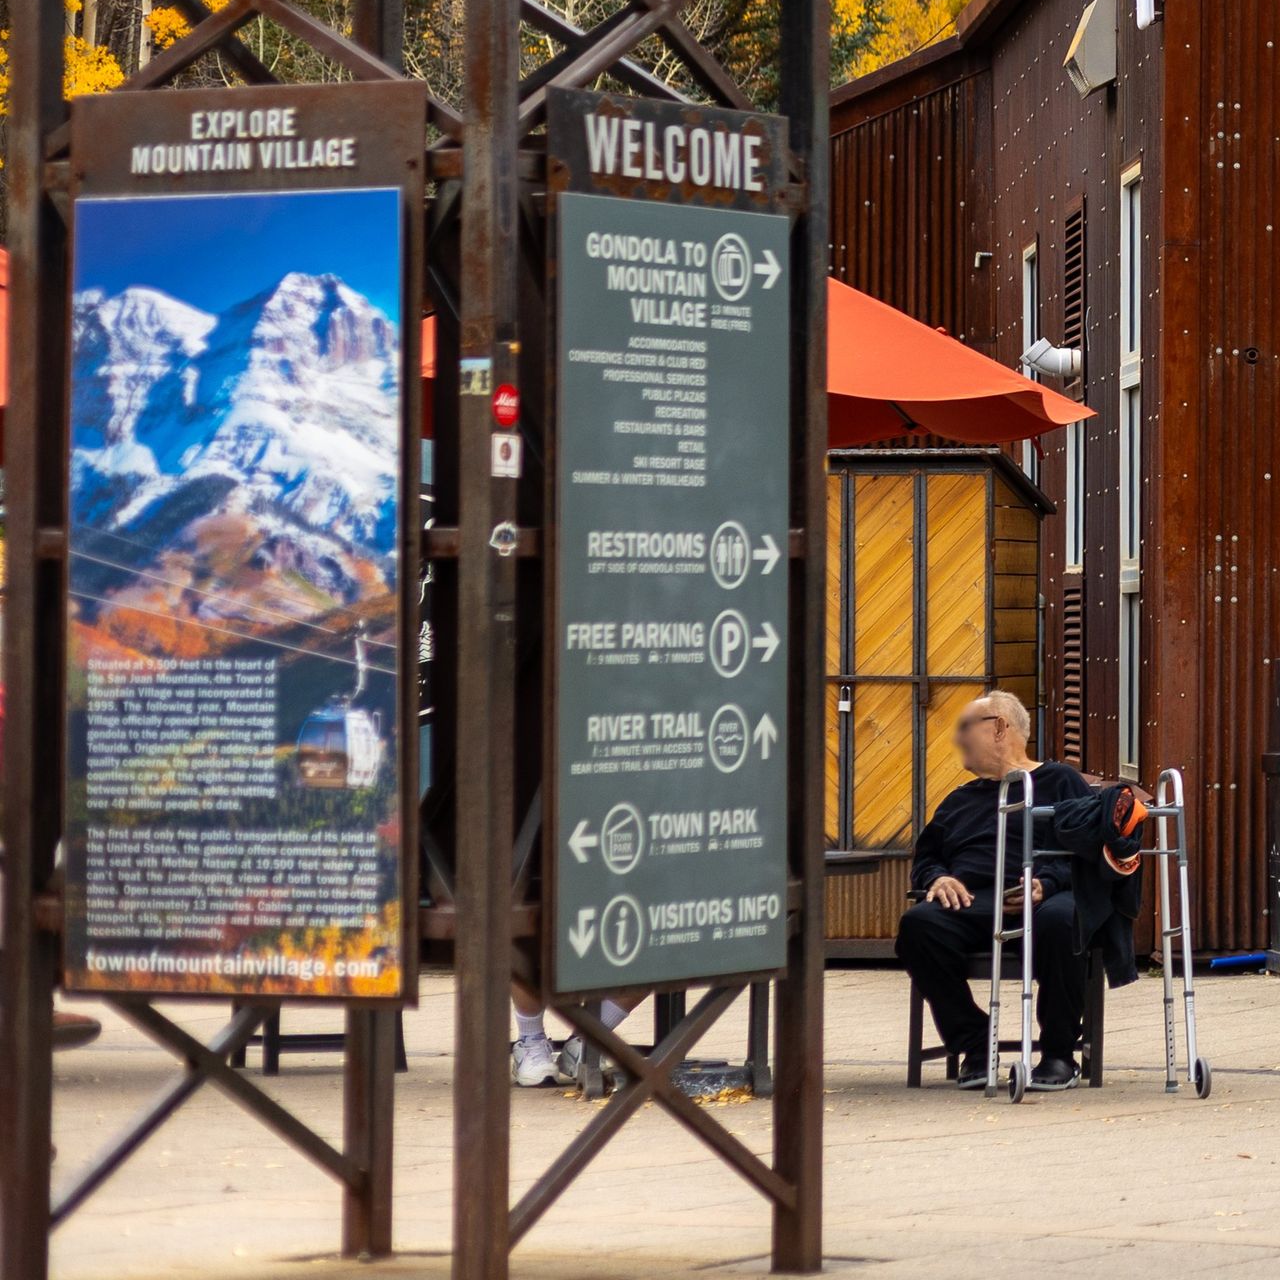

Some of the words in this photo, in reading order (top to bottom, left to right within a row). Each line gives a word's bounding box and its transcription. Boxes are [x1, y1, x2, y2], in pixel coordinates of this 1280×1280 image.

[190, 109, 296, 141] EXPLORE
[131, 143, 252, 176] MOUNTAIN
[259, 137, 358, 171] VILLAGE
[584, 111, 765, 194] WELCOME
[586, 233, 677, 265] GONDOLA
[682, 241, 706, 267] TO
[607, 266, 706, 297] MOUNTAIN
[631, 298, 706, 327] VILLAGE
[628, 337, 707, 352] ACCOMMODATIONS
[568, 350, 622, 364] CONFERENCE
[624, 353, 656, 366] CENTER
[658, 355, 664, 367] &
[666, 355, 687, 368] CLUB
[689, 357, 706, 369] RED
[603, 369, 664, 384] PROFESSIONAL
[666, 373, 706, 386] SERVICES
[642, 389, 671, 401] PUBLIC
[674, 390, 706, 402] PLAZAS
[655, 406, 706, 419] RECREATION
[614, 421, 672, 435] RESTAURANTS
[674, 424, 681, 435] &
[683, 424, 706, 436] BARS
[678, 441, 705, 453] RETAIL
[633, 456, 647, 468] SKI
[649, 457, 681, 469] RESORT
[683, 458, 706, 470] BASE
[572, 472, 610, 484] SUMMER
[612, 473, 619, 484] &
[621, 473, 653, 485] WINTER
[655, 474, 706, 487] TRAILHEADS
[588, 532, 705, 558] RESTROOMS
[566, 623, 615, 649] FREE
[621, 622, 704, 649] PARKING
[721, 623, 740, 666] P
[87, 659, 130, 670] Situated
[133, 659, 143, 670] at
[179, 659, 199, 670] feet
[202, 660, 212, 670] in
[215, 660, 231, 671] the
[234, 660, 261, 671] heart
[264, 660, 275, 671] of
[671, 652, 704, 664] MINUTES
[87, 673, 104, 684] the
[107, 673, 126, 684] San
[129, 673, 152, 684] Juan
[214, 673, 232, 684] the
[235, 673, 261, 684] Town
[264, 673, 275, 684] of
[87, 688, 134, 698] Mountain
[138, 688, 172, 700] Village
[175, 690, 195, 698] was
[198, 688, 262, 700] incorporated
[265, 688, 275, 698] in
[122, 701, 142, 712] The
[146, 701, 194, 714] following
[226, 702, 275, 712] Mountain
[87, 715, 119, 728] Village
[122, 715, 161, 728] officially
[164, 715, 199, 728] opened
[201, 715, 217, 726] the
[219, 715, 275, 728] three-stage
[587, 714, 645, 741] RIVER
[651, 712, 704, 739] TRAIL
[718, 722, 738, 732] RIVER
[87, 729, 126, 741] gondola
[128, 729, 139, 739] to
[141, 729, 157, 739] the
[195, 729, 250, 742] connecting
[253, 730, 275, 740] with
[611, 745, 639, 757] MINUTE
[642, 744, 660, 755] WITH
[663, 743, 691, 754] ACCESS
[694, 743, 704, 753] TO
[718, 746, 738, 756] TRAIL
[87, 800, 108, 809] over
[111, 798, 125, 809] 40
[128, 799, 162, 809] million
[165, 799, 199, 812] people
[201, 799, 213, 810] to
[648, 812, 703, 839] TOWN
[709, 809, 758, 836] PARK
[613, 832, 633, 842] TOWN
[731, 838, 763, 849] MINUTES
[613, 842, 633, 853] PARK
[667, 842, 701, 854] MINUTES
[648, 899, 732, 930] VISITORS
[738, 895, 780, 923] INFO
[87, 927, 140, 937] accessible
[143, 928, 162, 937] and
[666, 932, 701, 945] MINUTES
[735, 925, 767, 938] MINUTES
[86, 950, 380, 978] townofmountainvillage.com
